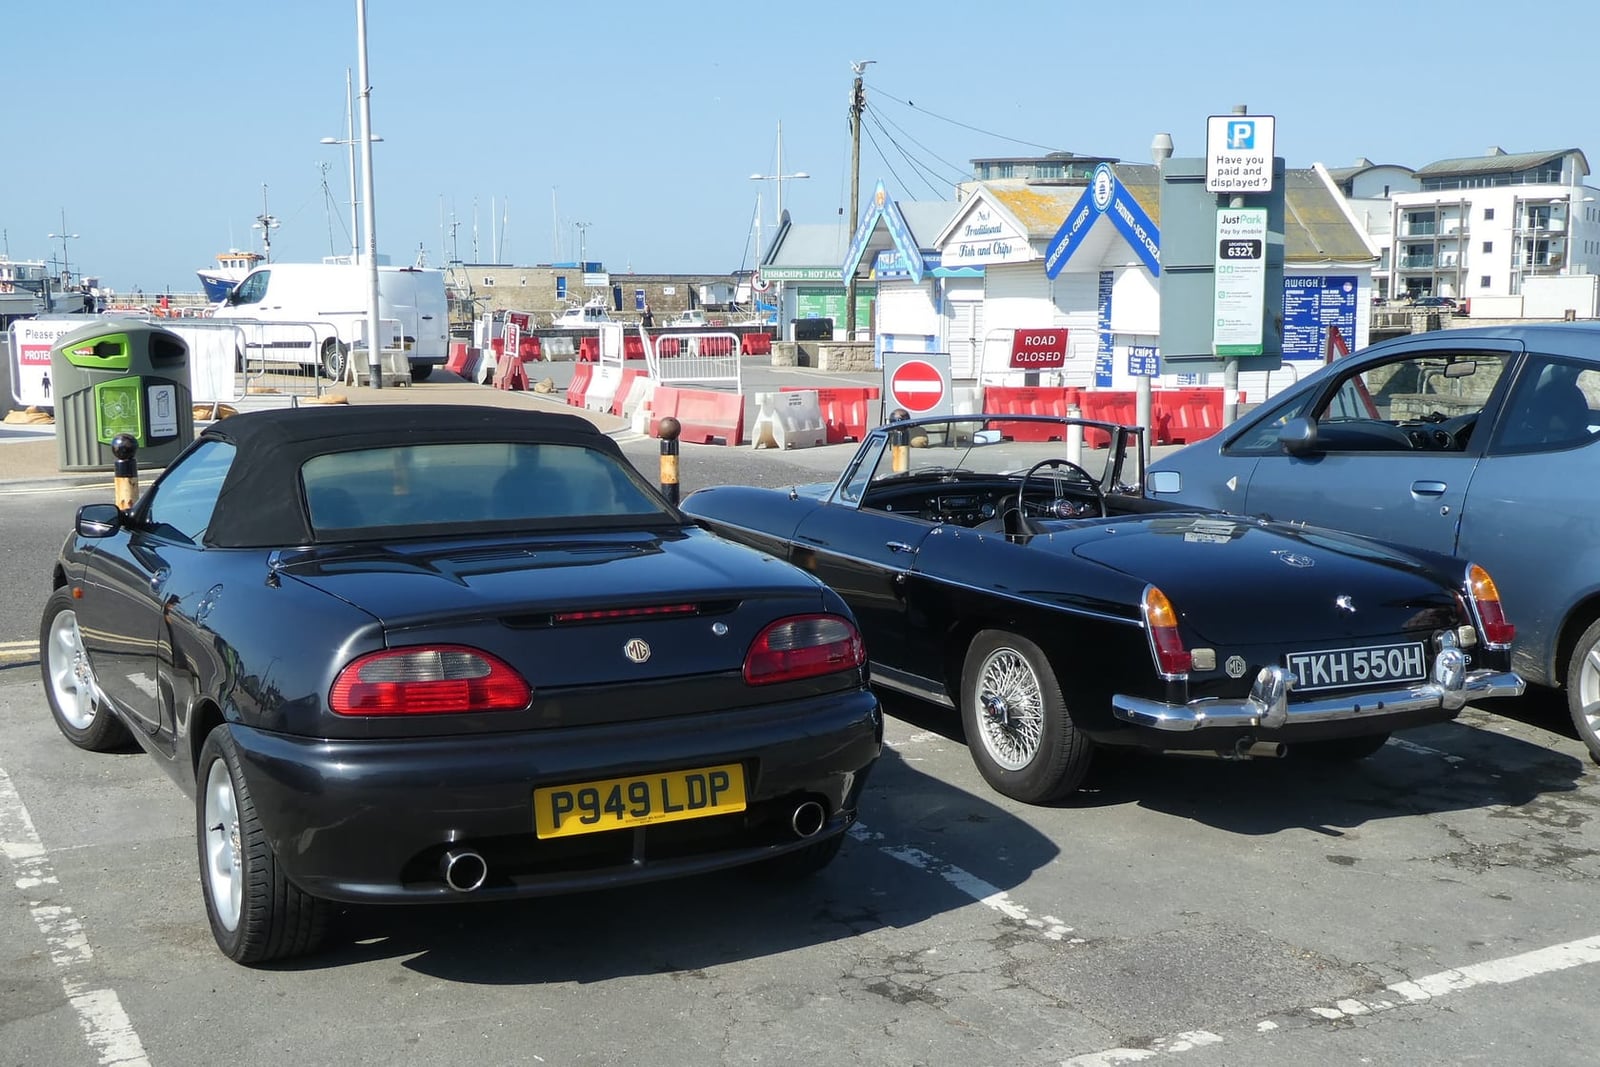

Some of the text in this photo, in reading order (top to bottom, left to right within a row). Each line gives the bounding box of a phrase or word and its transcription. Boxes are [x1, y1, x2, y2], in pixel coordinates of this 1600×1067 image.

[1233, 123, 1251, 147] P
[1216, 155, 1264, 167] Have you
[1217, 166, 1262, 178] paid and
[1221, 214, 1262, 225] JustPark
[964, 222, 1002, 237] Traditional
[1114, 198, 1161, 265] DRINKS ICE CREA
[1046, 205, 1090, 272] BURGERS CHIPS
[958, 241, 1013, 259] Fish and Chips
[806, 269, 824, 279] HOT
[824, 269, 843, 279] JACK
[1284, 279, 1318, 288] AWEIGH
[25, 329, 54, 340] Please
[1025, 336, 1056, 346] ROAD
[1016, 352, 1061, 362] CLOSED
[626, 639, 648, 661] MG
[1226, 657, 1245, 677] MG
[550, 770, 730, 830] P949 LDP
